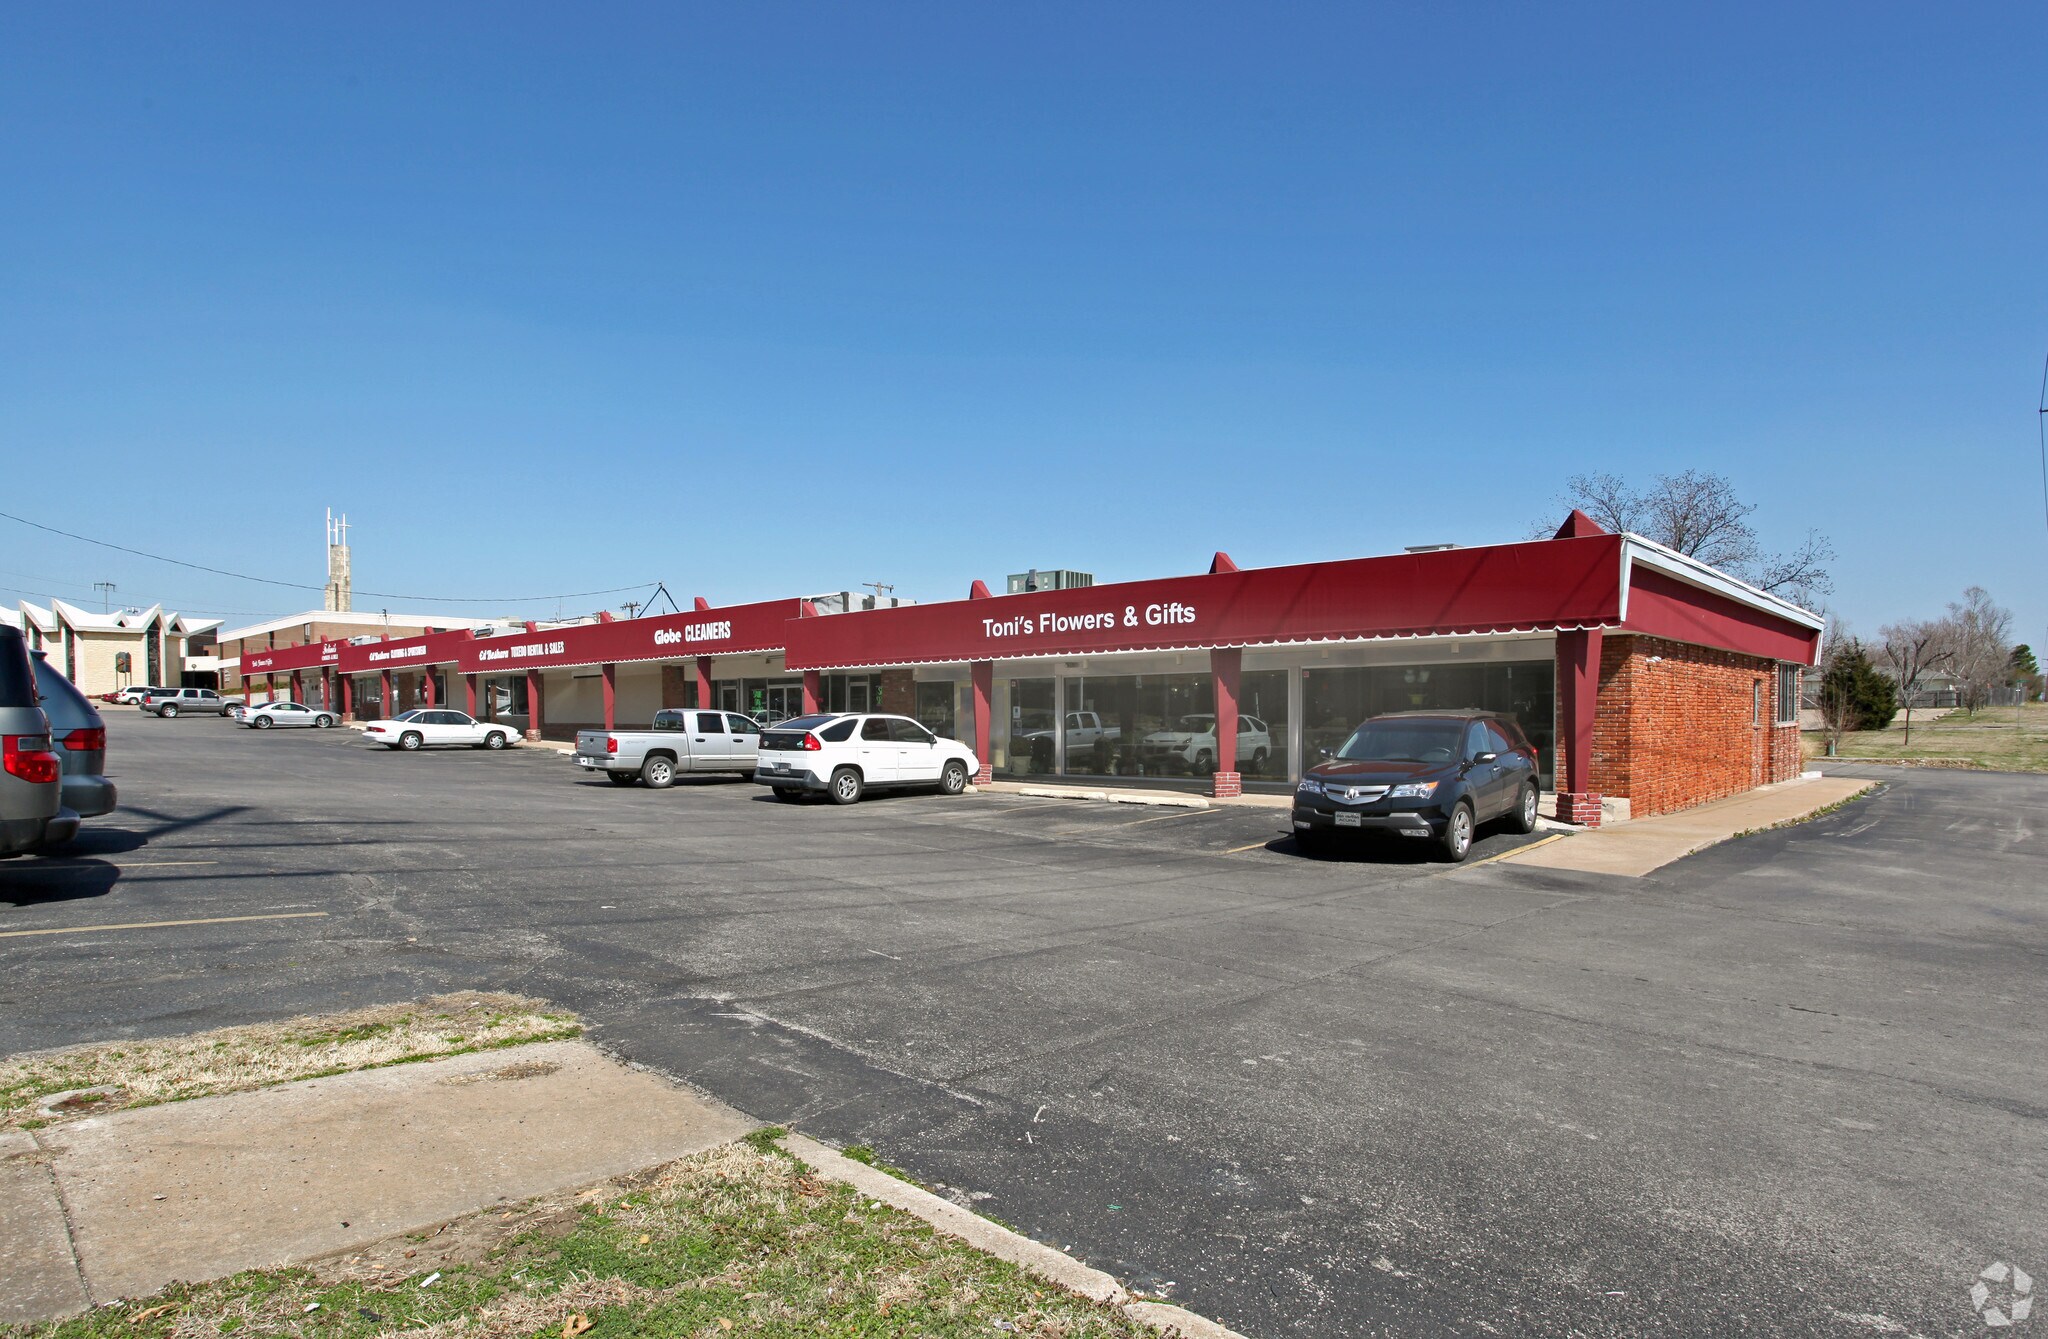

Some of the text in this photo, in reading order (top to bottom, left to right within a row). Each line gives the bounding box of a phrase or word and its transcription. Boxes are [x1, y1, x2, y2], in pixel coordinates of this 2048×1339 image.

[654, 620, 731, 645] Globe CLEANERS
[982, 602, 1196, 638] Toni's Flowers & Gifts
[510, 645, 527, 658] TUXEDO
[527, 643, 545, 656] RENTAL
[544, 643, 549, 655] &
[549, 641, 565, 654] SALES
